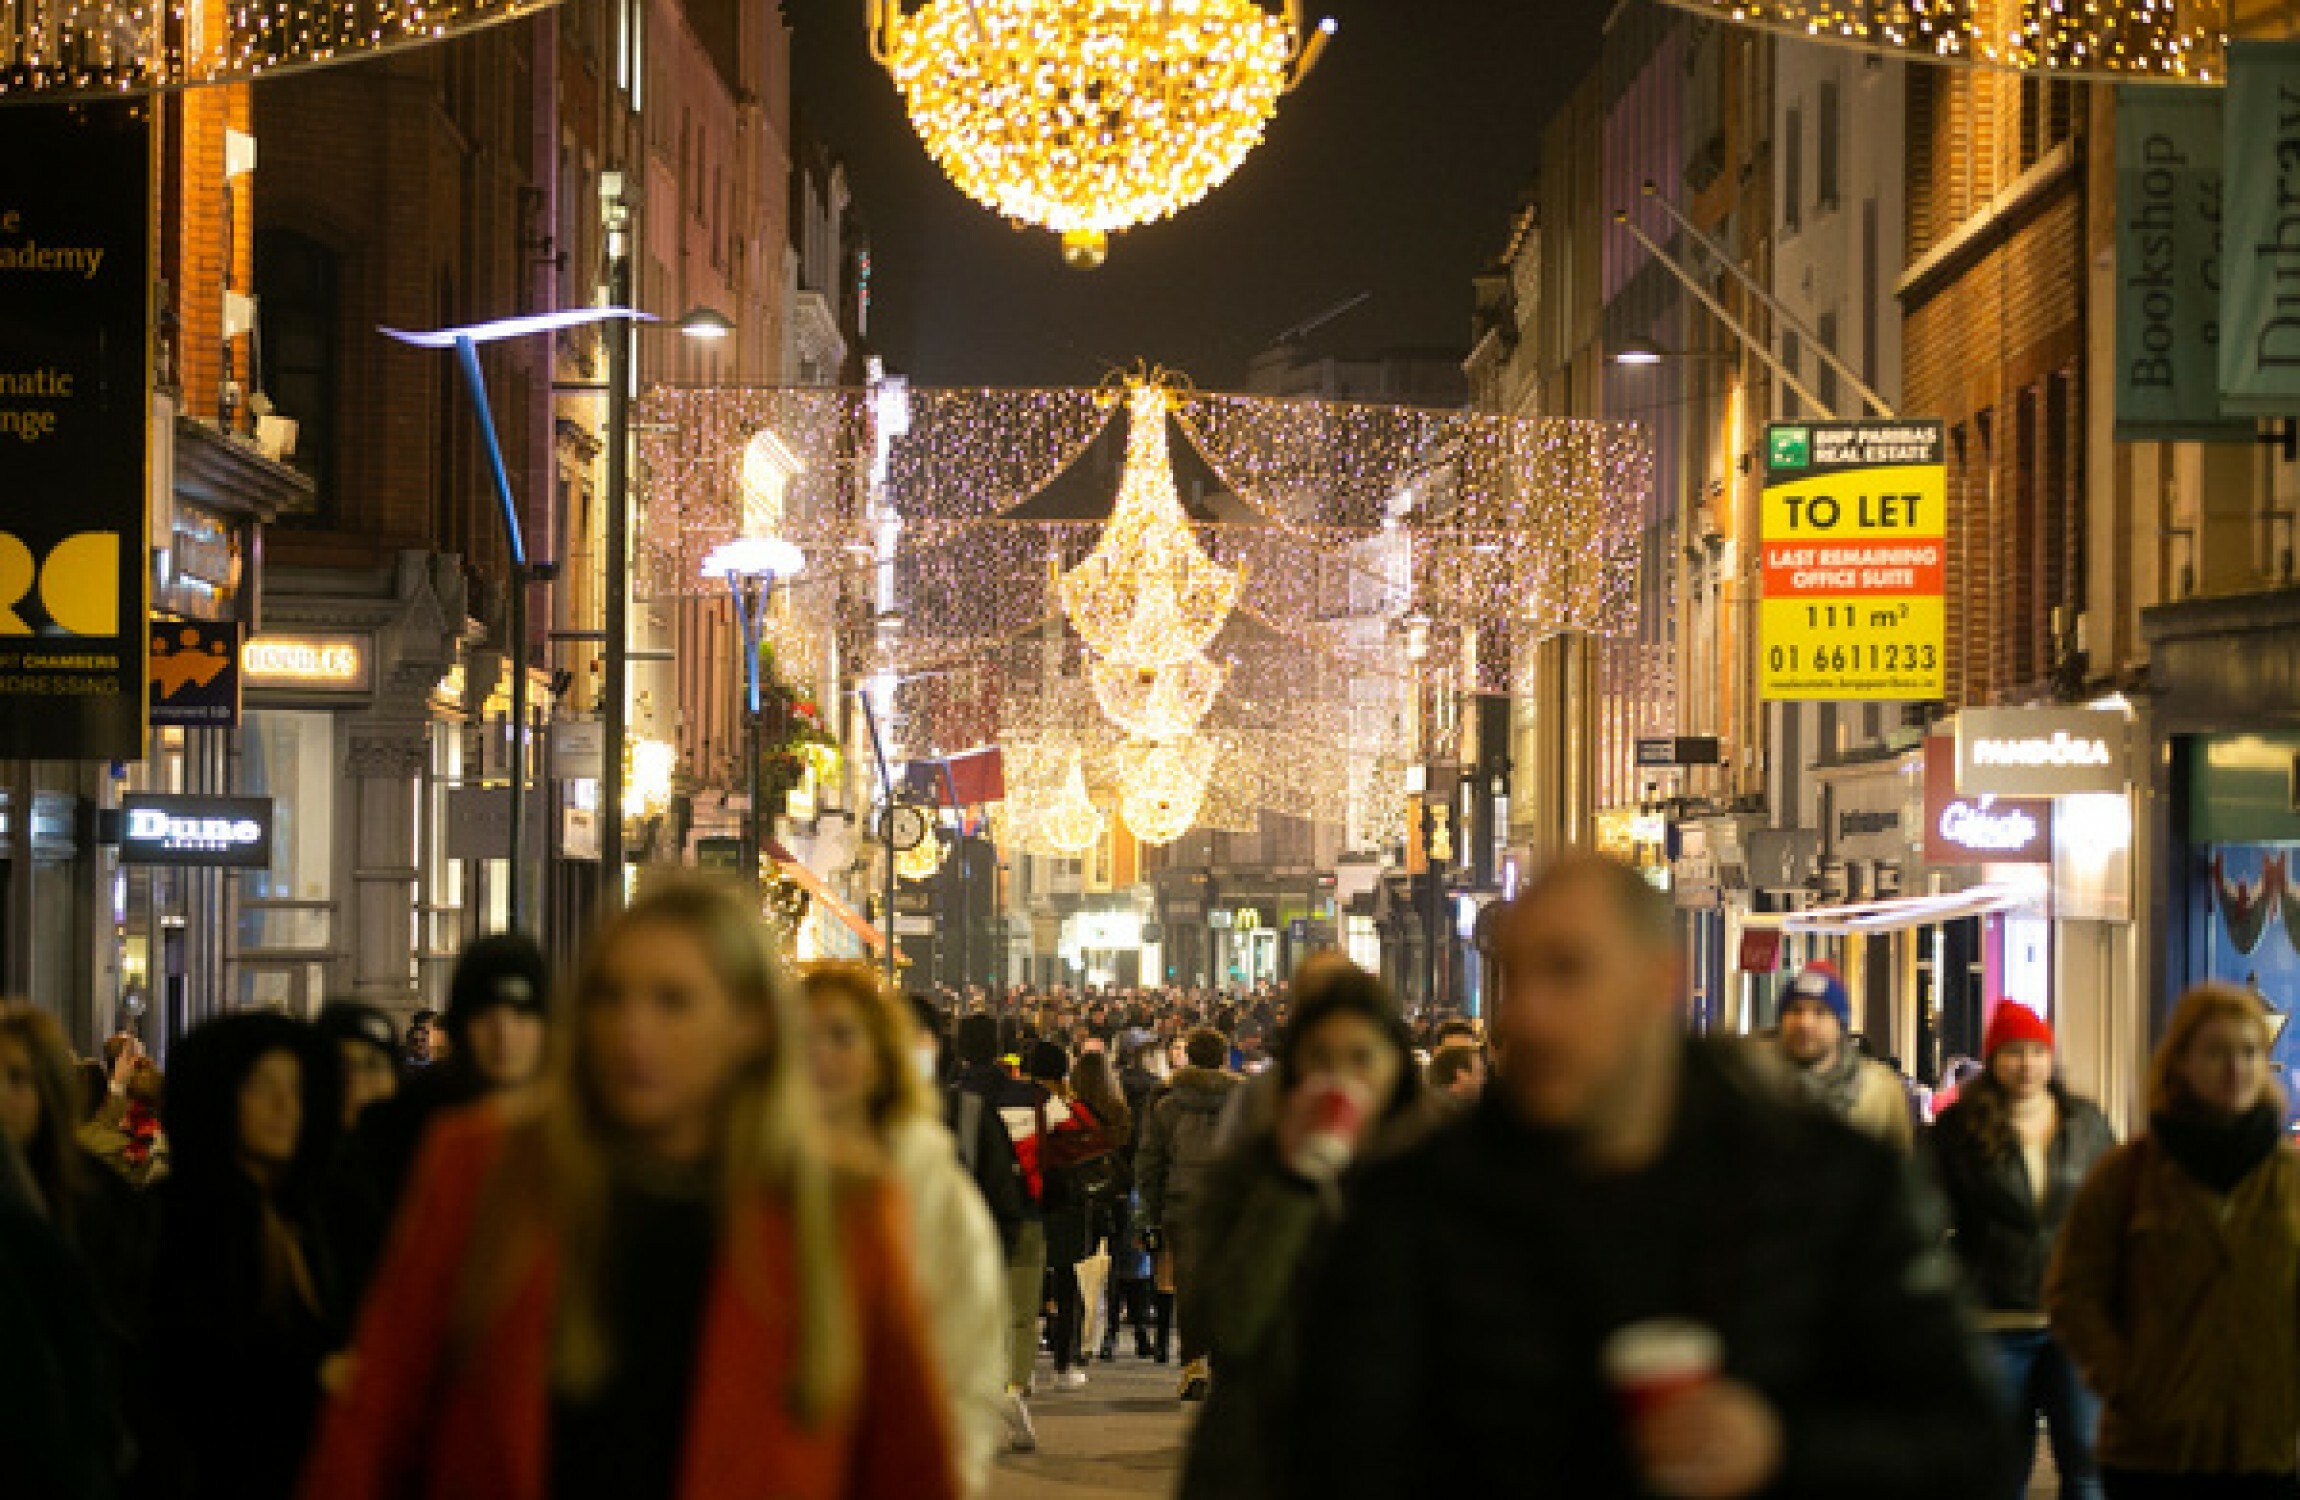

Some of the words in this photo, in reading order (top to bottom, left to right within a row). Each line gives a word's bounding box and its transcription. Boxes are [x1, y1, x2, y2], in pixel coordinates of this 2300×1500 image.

[2128, 133, 2188, 387] Bookshop
[1814, 446, 1860, 463] REAL
[1865, 445, 1931, 462] ESTATE
[1783, 495, 1840, 531] TO
[1858, 493, 1923, 529] LET
[1769, 548, 1814, 568] LAST
[1819, 545, 1938, 566] REMAINING
[1791, 570, 1856, 589] OFFICE
[1861, 568, 1915, 588] SUITE
[1806, 604, 1856, 629] 111
[1768, 644, 1799, 673] 01
[1812, 643, 1938, 673] 6611233
[128, 808, 262, 844] Dune
